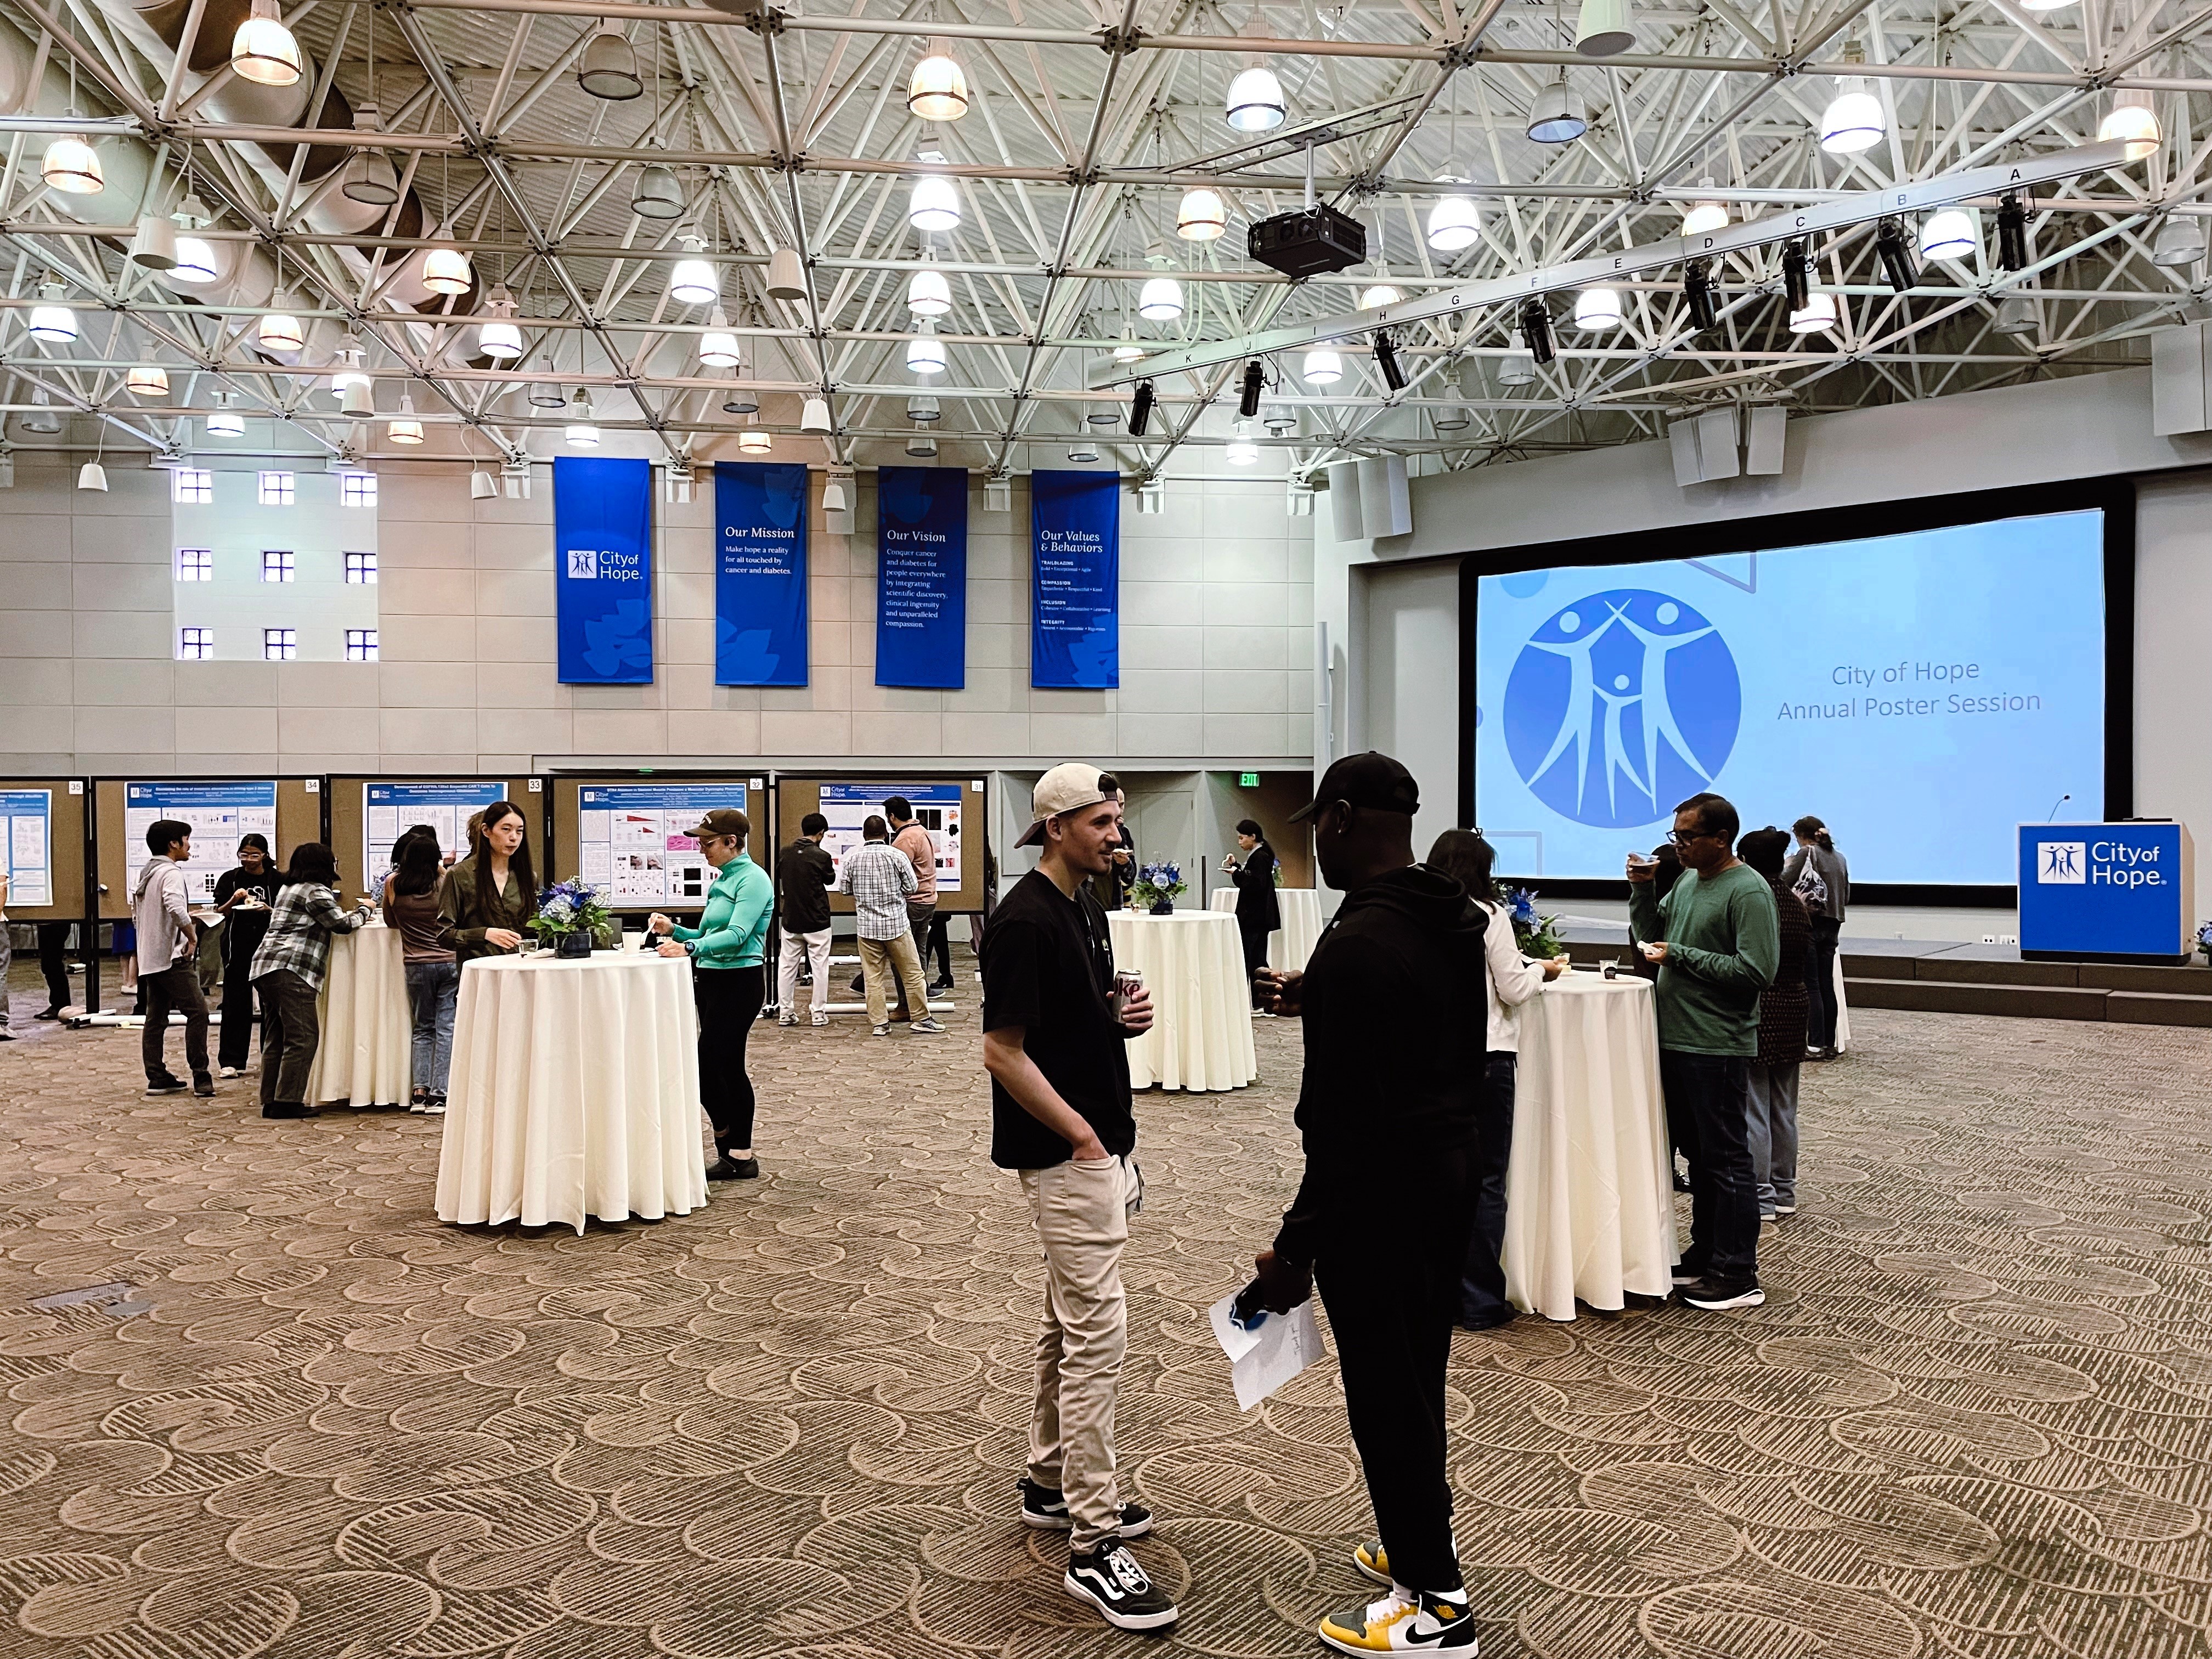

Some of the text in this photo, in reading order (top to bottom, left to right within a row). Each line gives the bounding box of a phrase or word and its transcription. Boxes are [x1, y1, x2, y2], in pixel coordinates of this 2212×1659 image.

[2010, 169, 2021, 180] A
[1898, 194, 1906, 205] B
[1796, 217, 1805, 227] C
[1705, 238, 1713, 249] D
[1615, 258, 1622, 269] E
[1531, 276, 1538, 287] F
[1452, 295, 1459, 305] G
[1380, 311, 1386, 320] H
[1246, 341, 1251, 350] J
[1186, 354, 1192, 363] K
[725, 527, 794, 538] Our Mission
[887, 530, 946, 542] Our Vision
[1042, 530, 1100, 541] Our Values
[744, 546, 761, 554] hope
[768, 547, 789, 555] reality
[887, 549, 914, 557] Conquer
[1041, 542, 1103, 553] & Behaviors
[774, 557, 782, 566] by
[886, 579, 930, 589] by integrating
[910, 600, 940, 610] ingenuity
[1832, 661, 1980, 688] City of Hope
[1778, 692, 2041, 720] Annual Poster Session
[1241, 774, 1257, 786] EXIT
